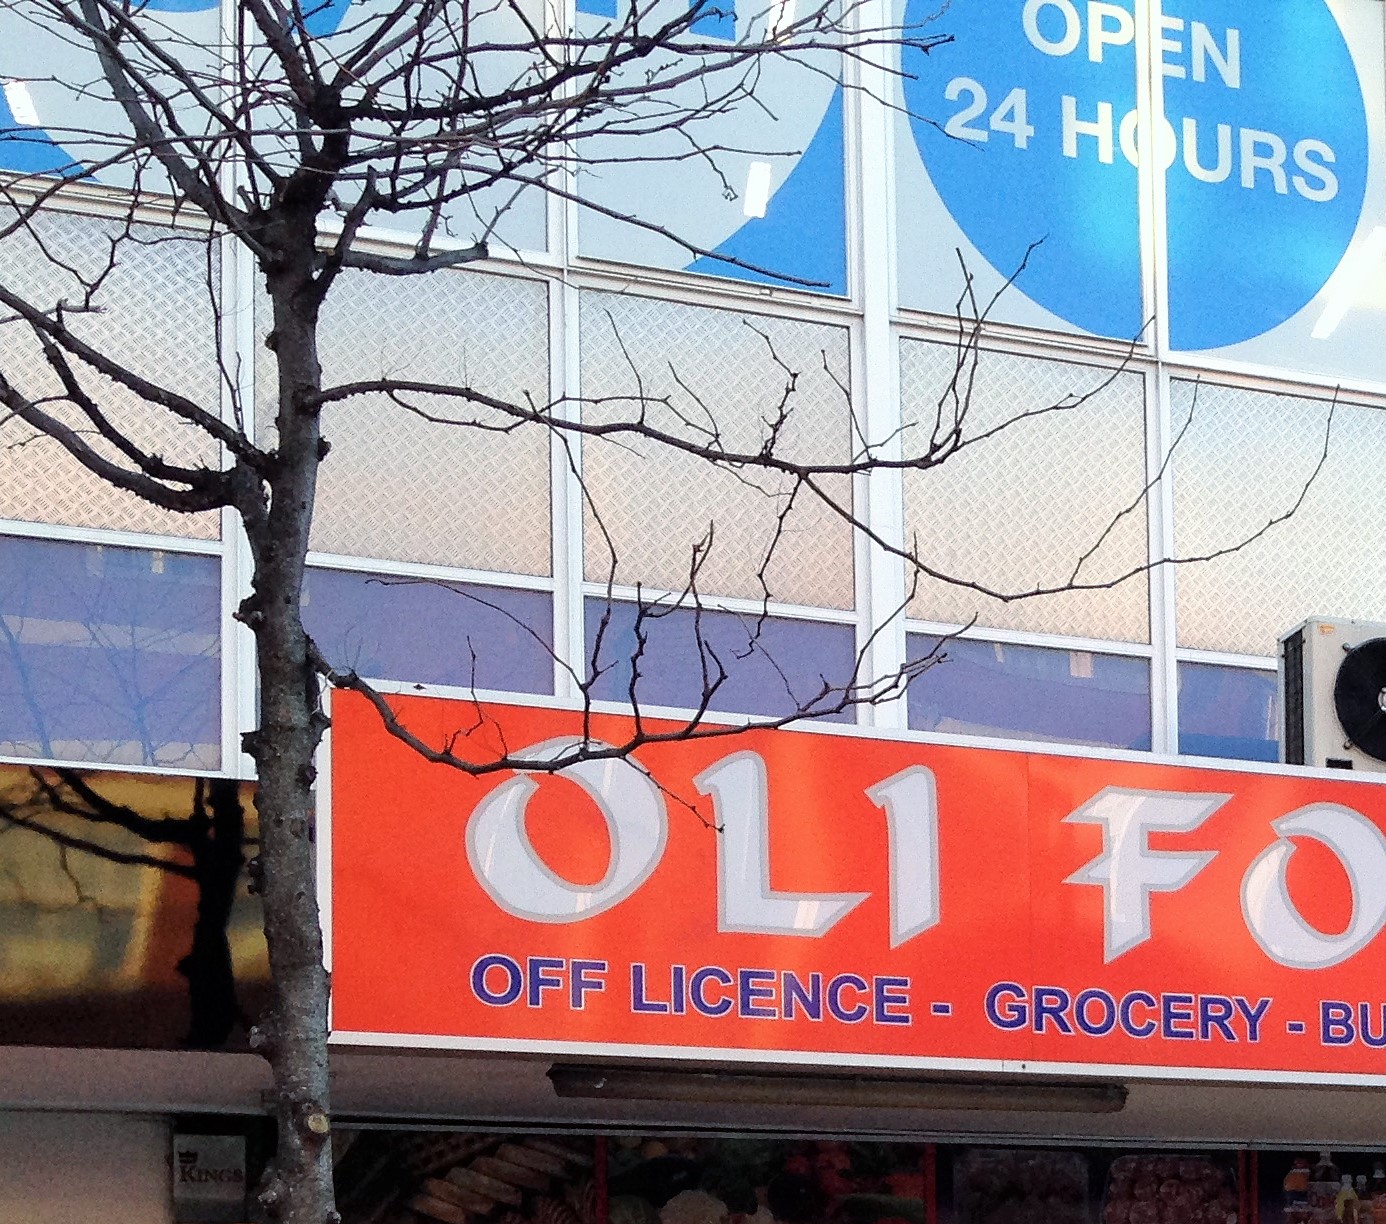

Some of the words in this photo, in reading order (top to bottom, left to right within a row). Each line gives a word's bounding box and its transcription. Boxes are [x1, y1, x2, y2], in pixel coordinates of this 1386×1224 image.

[1022, 0, 1240, 88] OPEN
[943, 77, 1034, 149] 24
[1062, 95, 1339, 202] HOURS
[465, 735, 941, 949] OLI
[469, 953, 608, 1008] OFF
[629, 962, 913, 1026] LICENCE
[985, 980, 1273, 1043] GROCERY
[179, 1166, 243, 1184] KINGS
